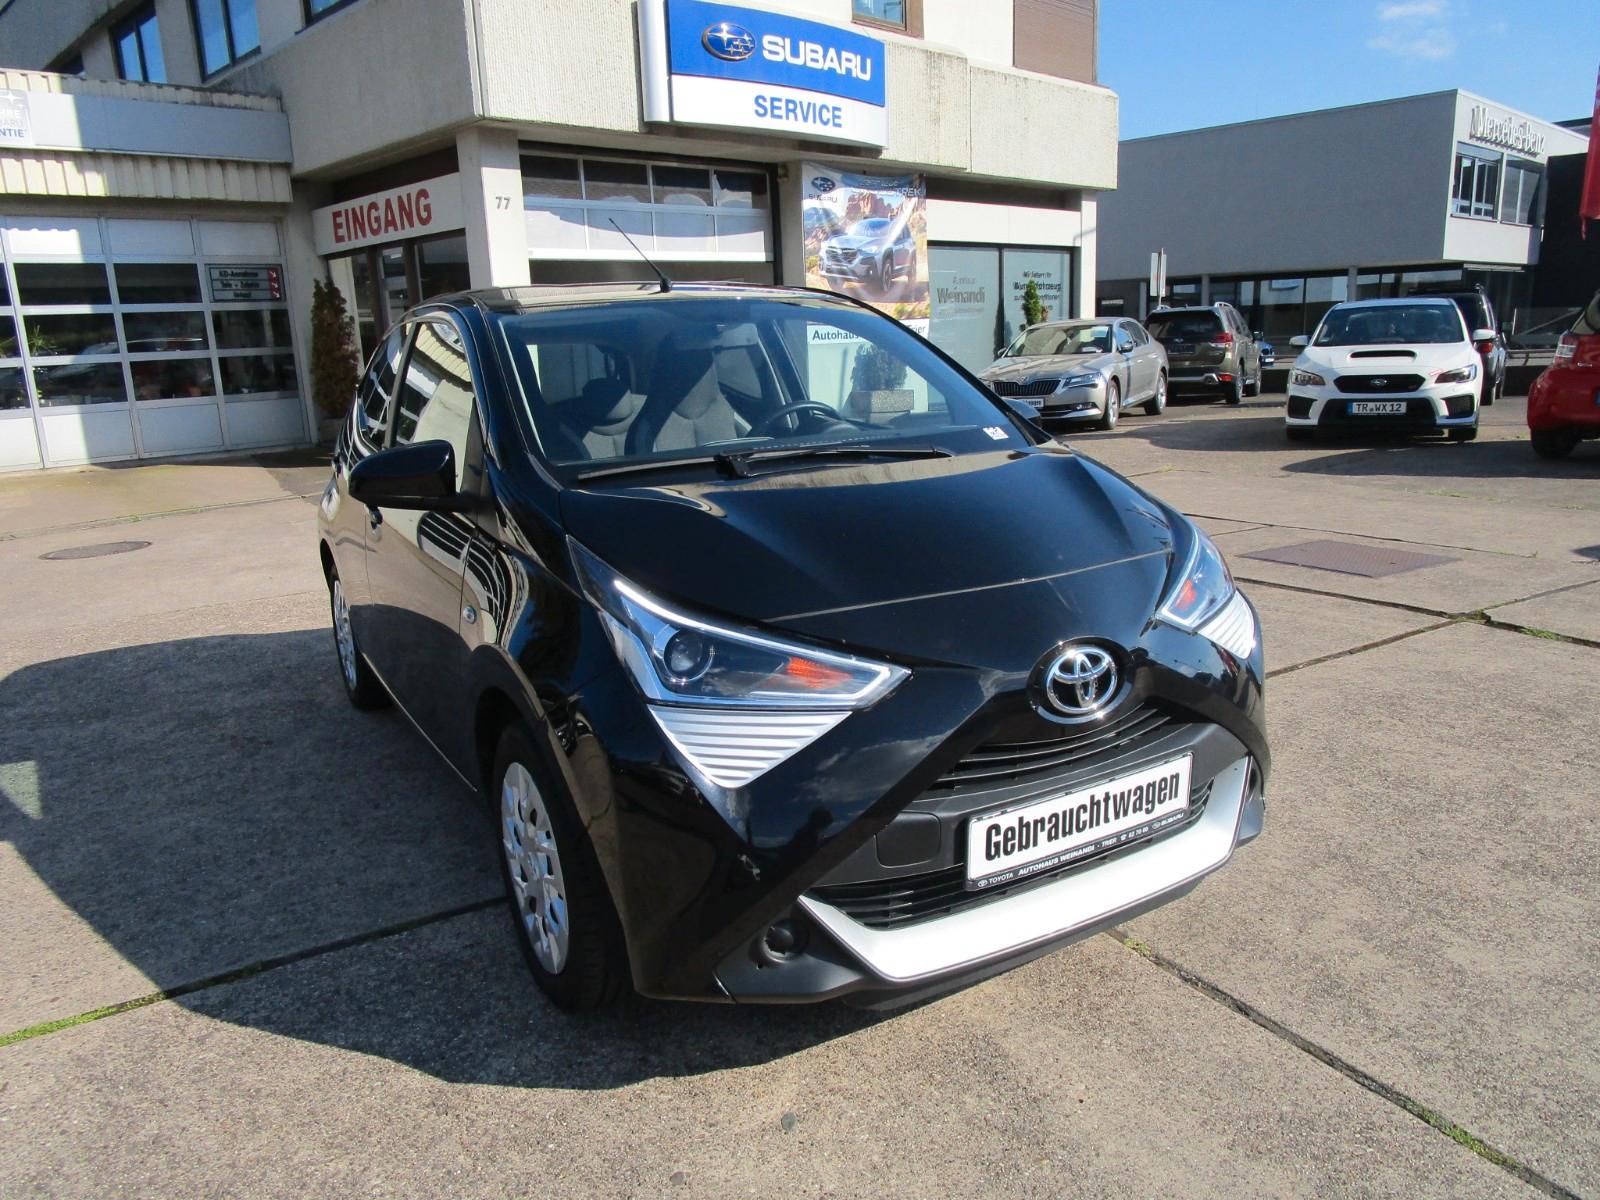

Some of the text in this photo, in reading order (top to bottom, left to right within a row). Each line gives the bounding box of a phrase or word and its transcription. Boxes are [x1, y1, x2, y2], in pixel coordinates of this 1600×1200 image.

[761, 34, 872, 81] SUBARU
[754, 94, 843, 128] SERVICE
[332, 188, 432, 243] EINGANG
[495, 196, 511, 209] 77
[985, 772, 1180, 861] Gebrauchtwagen
[989, 872, 1014, 884] TOYOTA
[1018, 858, 1059, 876] AUTOHAUS
